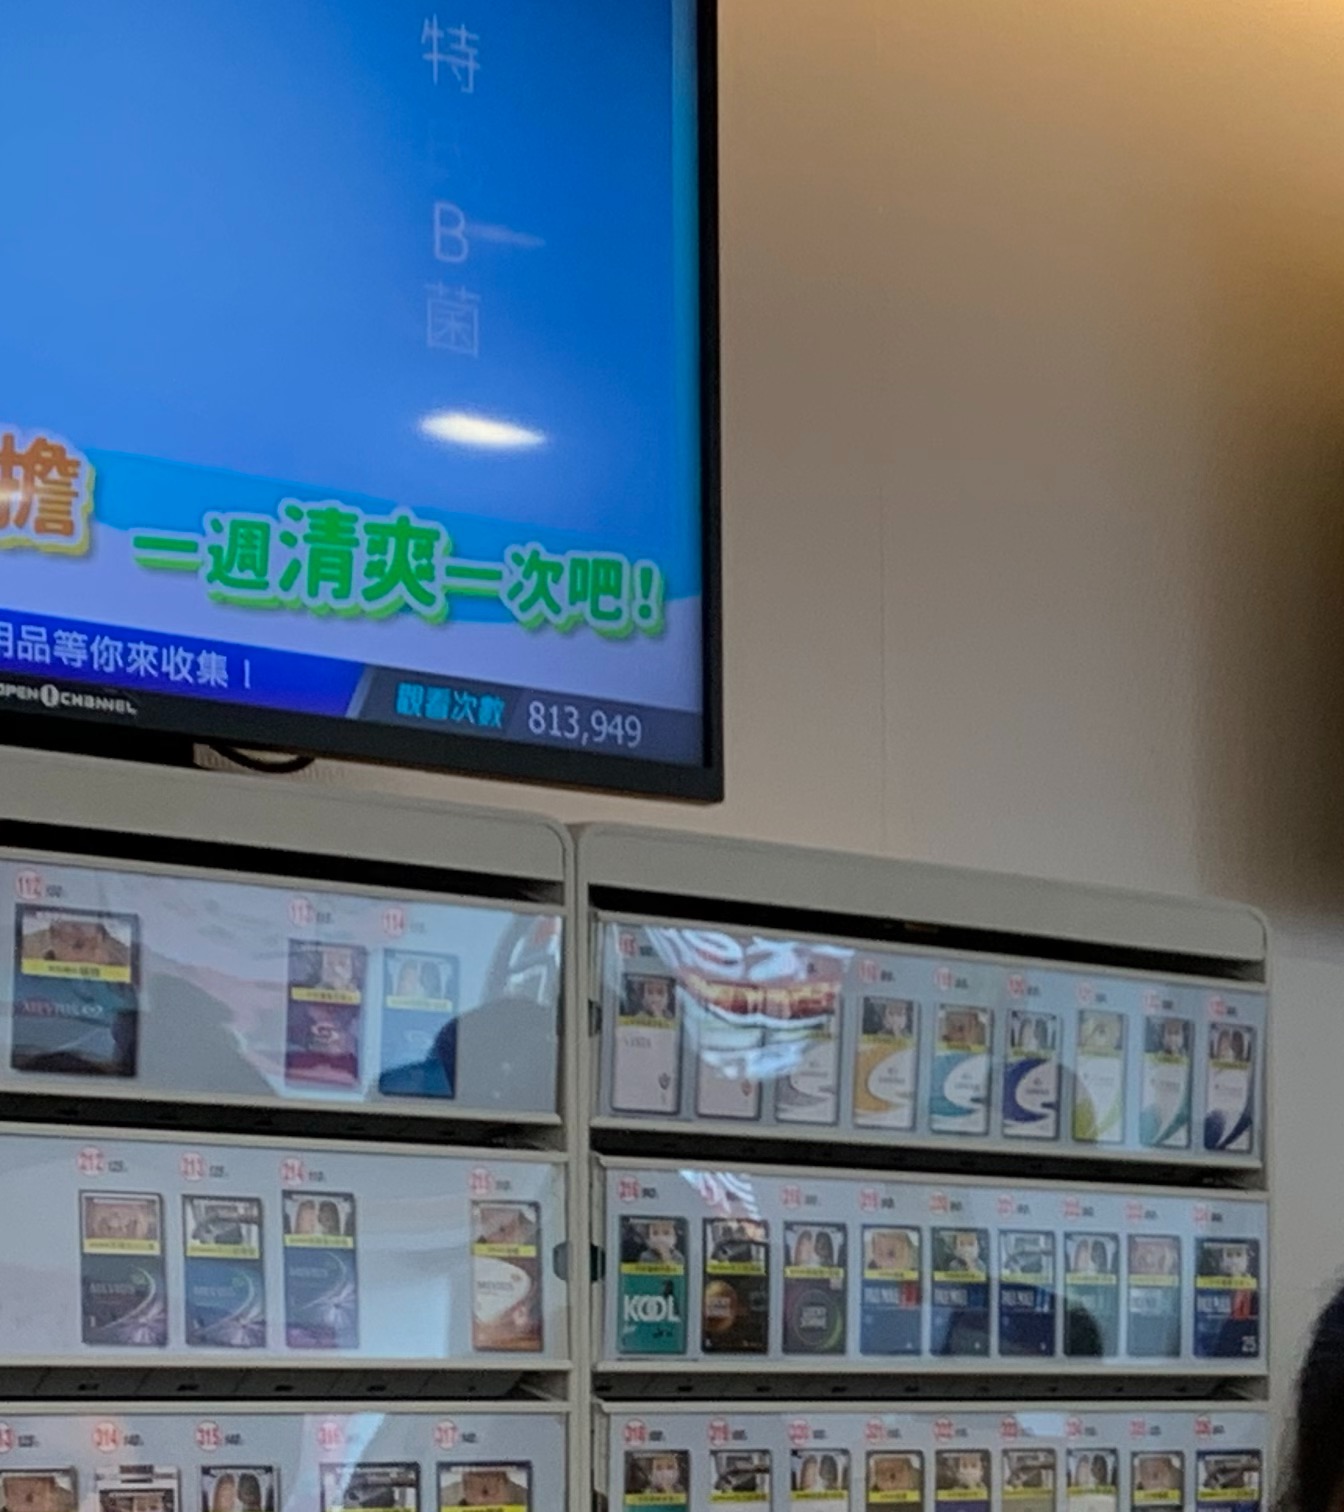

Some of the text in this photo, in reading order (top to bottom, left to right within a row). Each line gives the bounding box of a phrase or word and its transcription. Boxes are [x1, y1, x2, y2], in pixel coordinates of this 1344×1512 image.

[133, 503, 662, 626] 一週清爽一次吧!
[396, 682, 505, 727] 觀看次數
[528, 701, 642, 748] 813,949
[624, 1293, 681, 1323] KOOL
